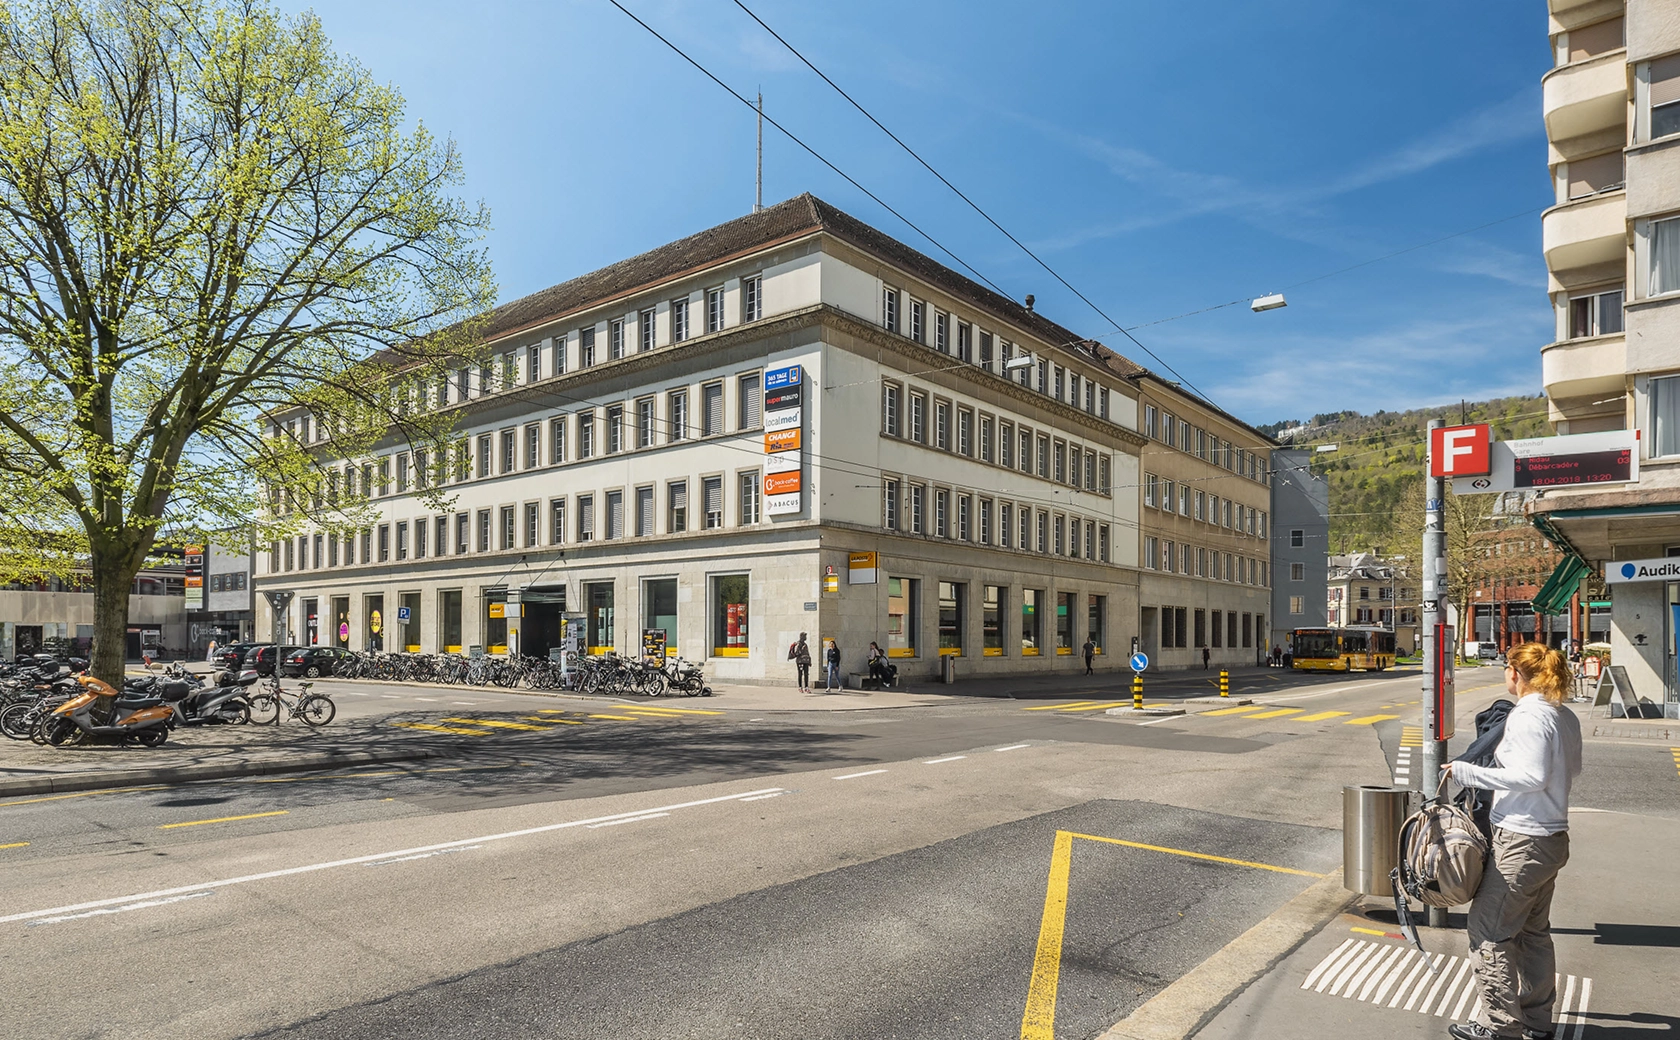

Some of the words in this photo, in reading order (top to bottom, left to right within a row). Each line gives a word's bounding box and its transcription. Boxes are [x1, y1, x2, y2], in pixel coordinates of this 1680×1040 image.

[766, 413, 797, 427] localmed
[768, 431, 796, 441] CHANGE
[1513, 440, 1544, 449] Bahnhof
[1443, 428, 1477, 473] F
[1532, 475, 1581, 485] 18.04.2018
[1587, 473, 1612, 482] 13:20
[773, 499, 799, 508] ABACUS
[400, 608, 407, 617] P
